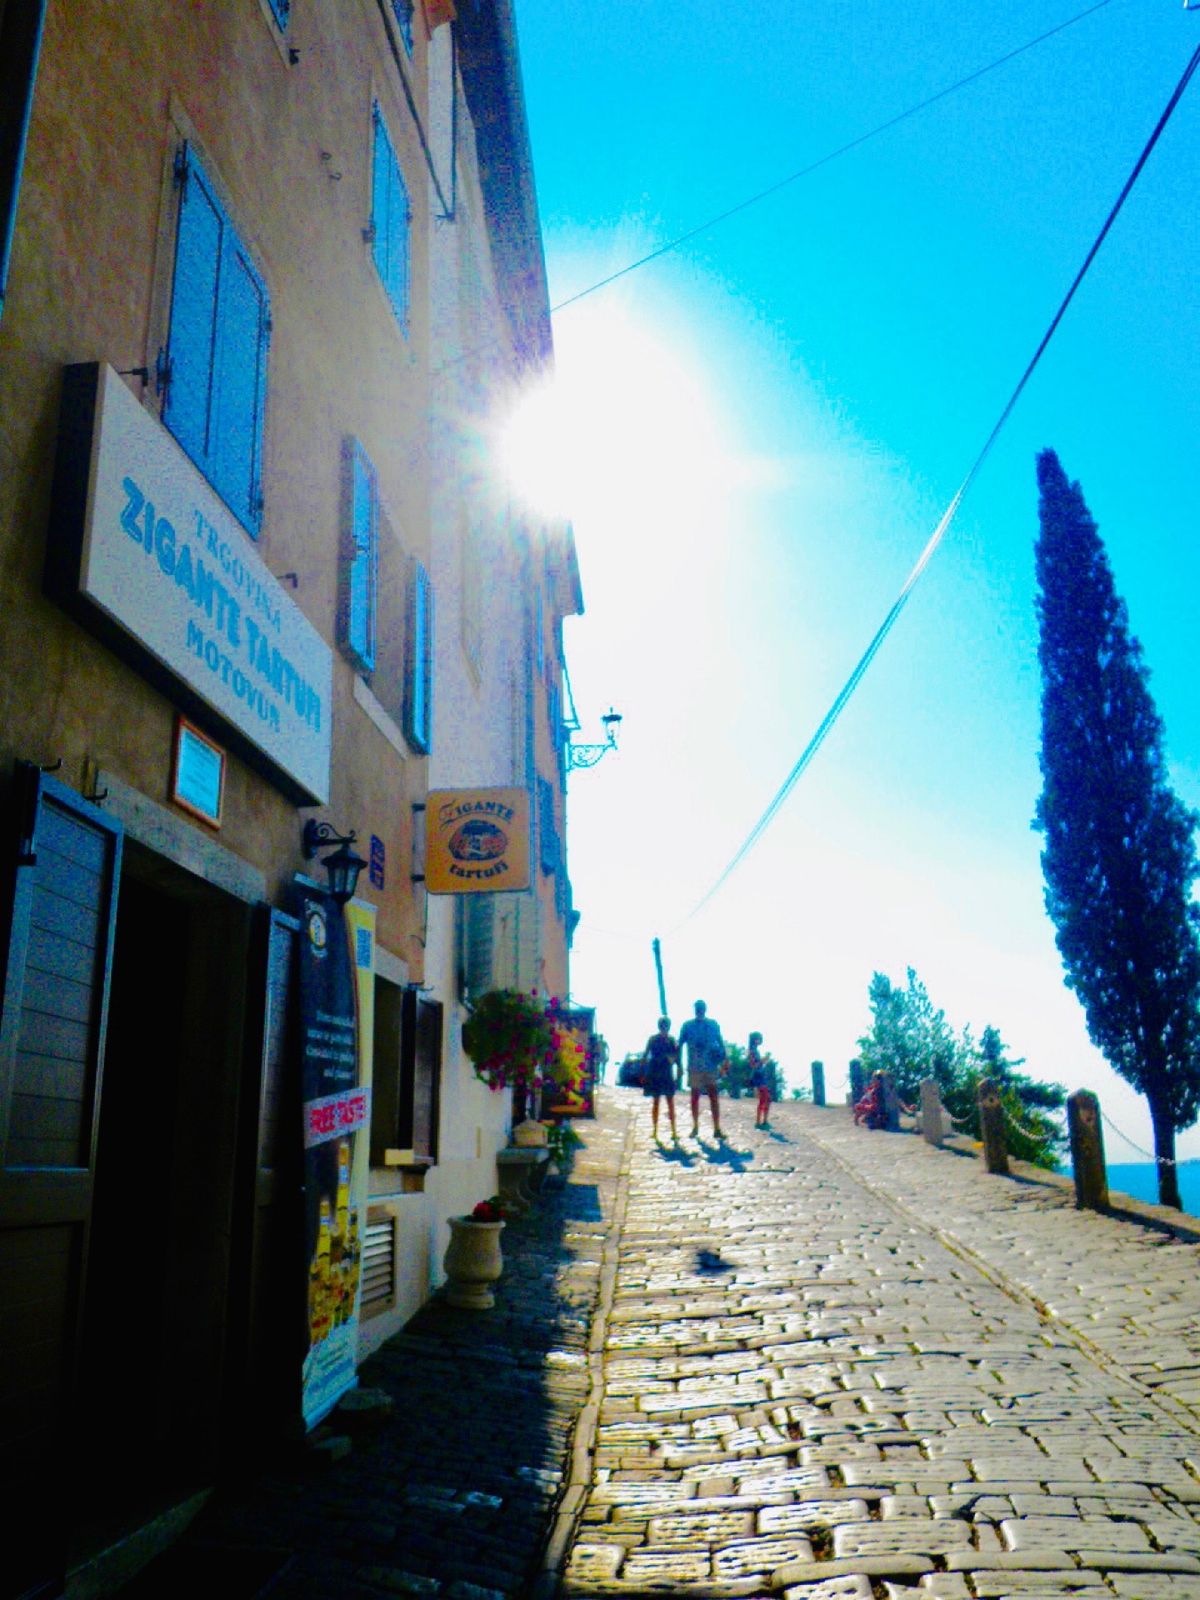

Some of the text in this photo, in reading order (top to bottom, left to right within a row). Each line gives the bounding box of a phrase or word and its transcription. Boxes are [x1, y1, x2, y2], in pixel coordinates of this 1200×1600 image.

[119, 476, 321, 733] ZIGANTE TARTUFI
[439, 799, 514, 832] ZIGANTE
